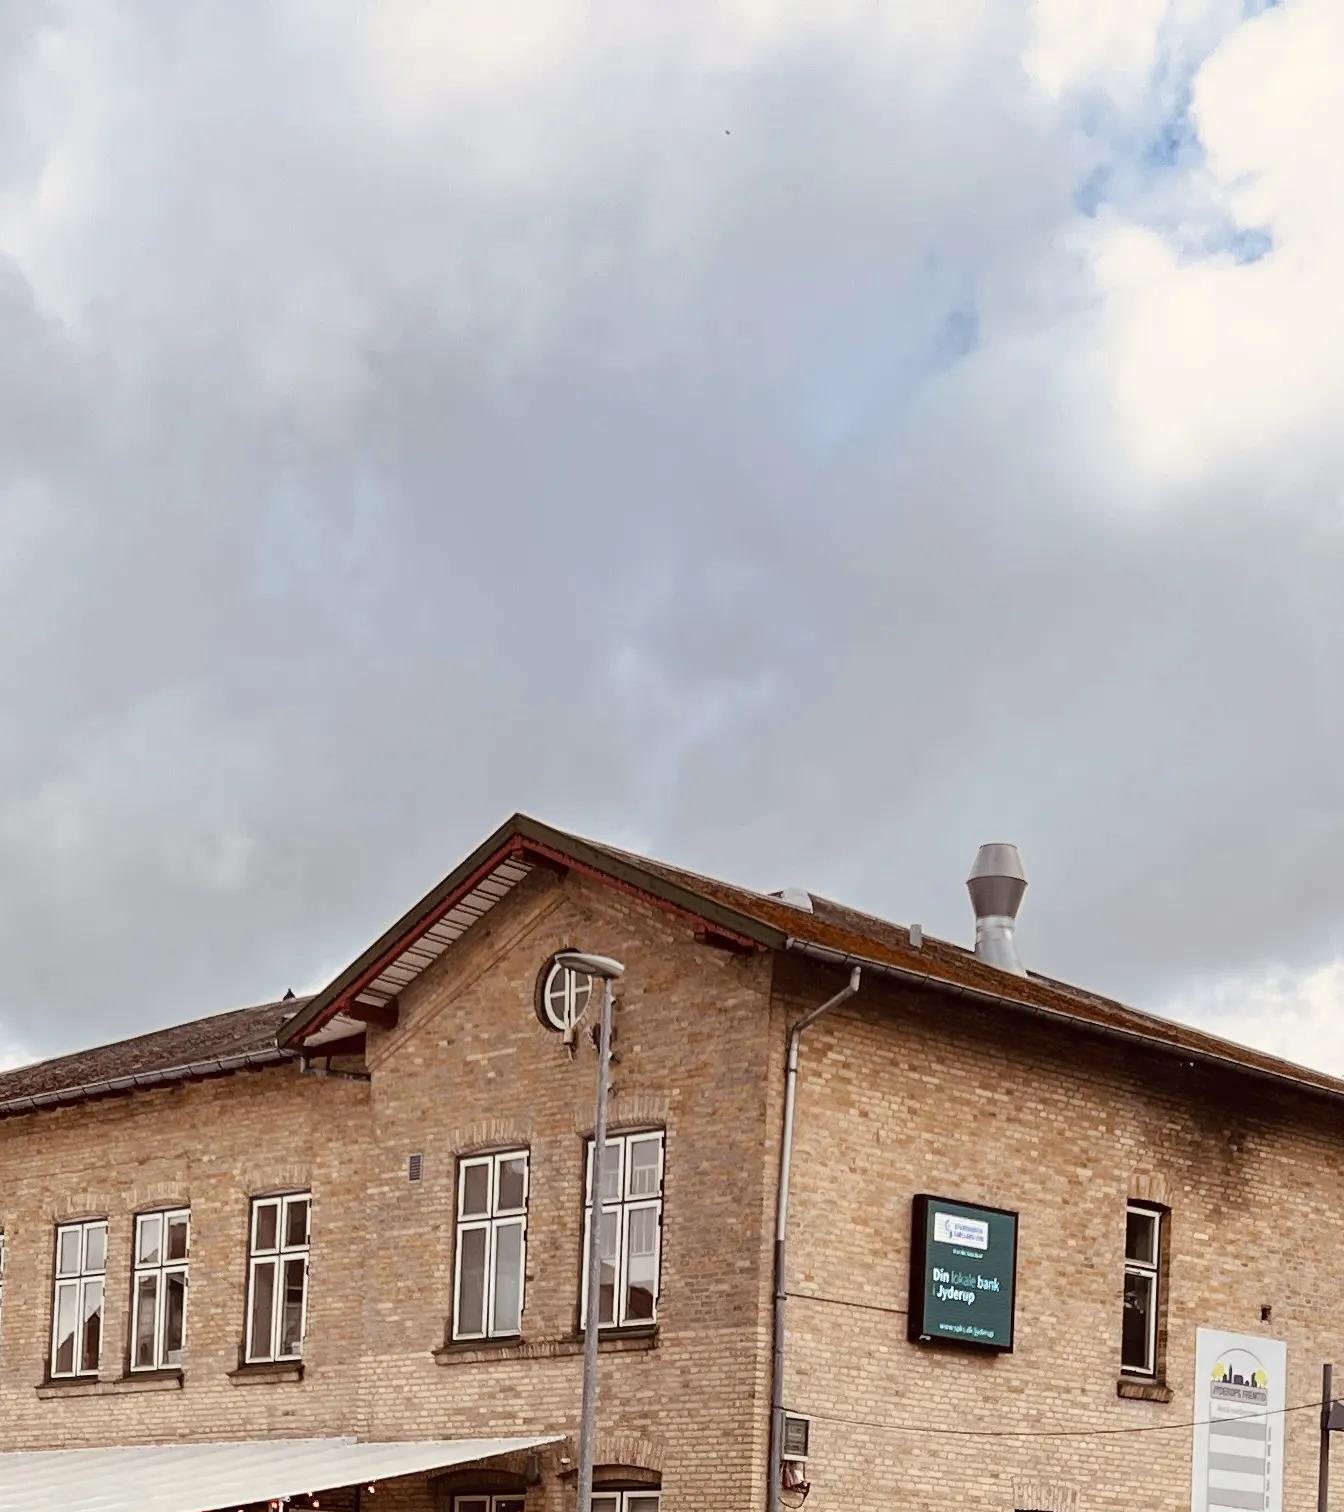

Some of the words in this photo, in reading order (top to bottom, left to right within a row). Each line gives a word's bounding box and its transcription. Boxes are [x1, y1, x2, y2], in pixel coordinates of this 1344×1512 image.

[933, 1267, 949, 1283] Din
[951, 1270, 976, 1288] lokale
[977, 1275, 1000, 1292] bank
[937, 1285, 975, 1305] Jyderup
